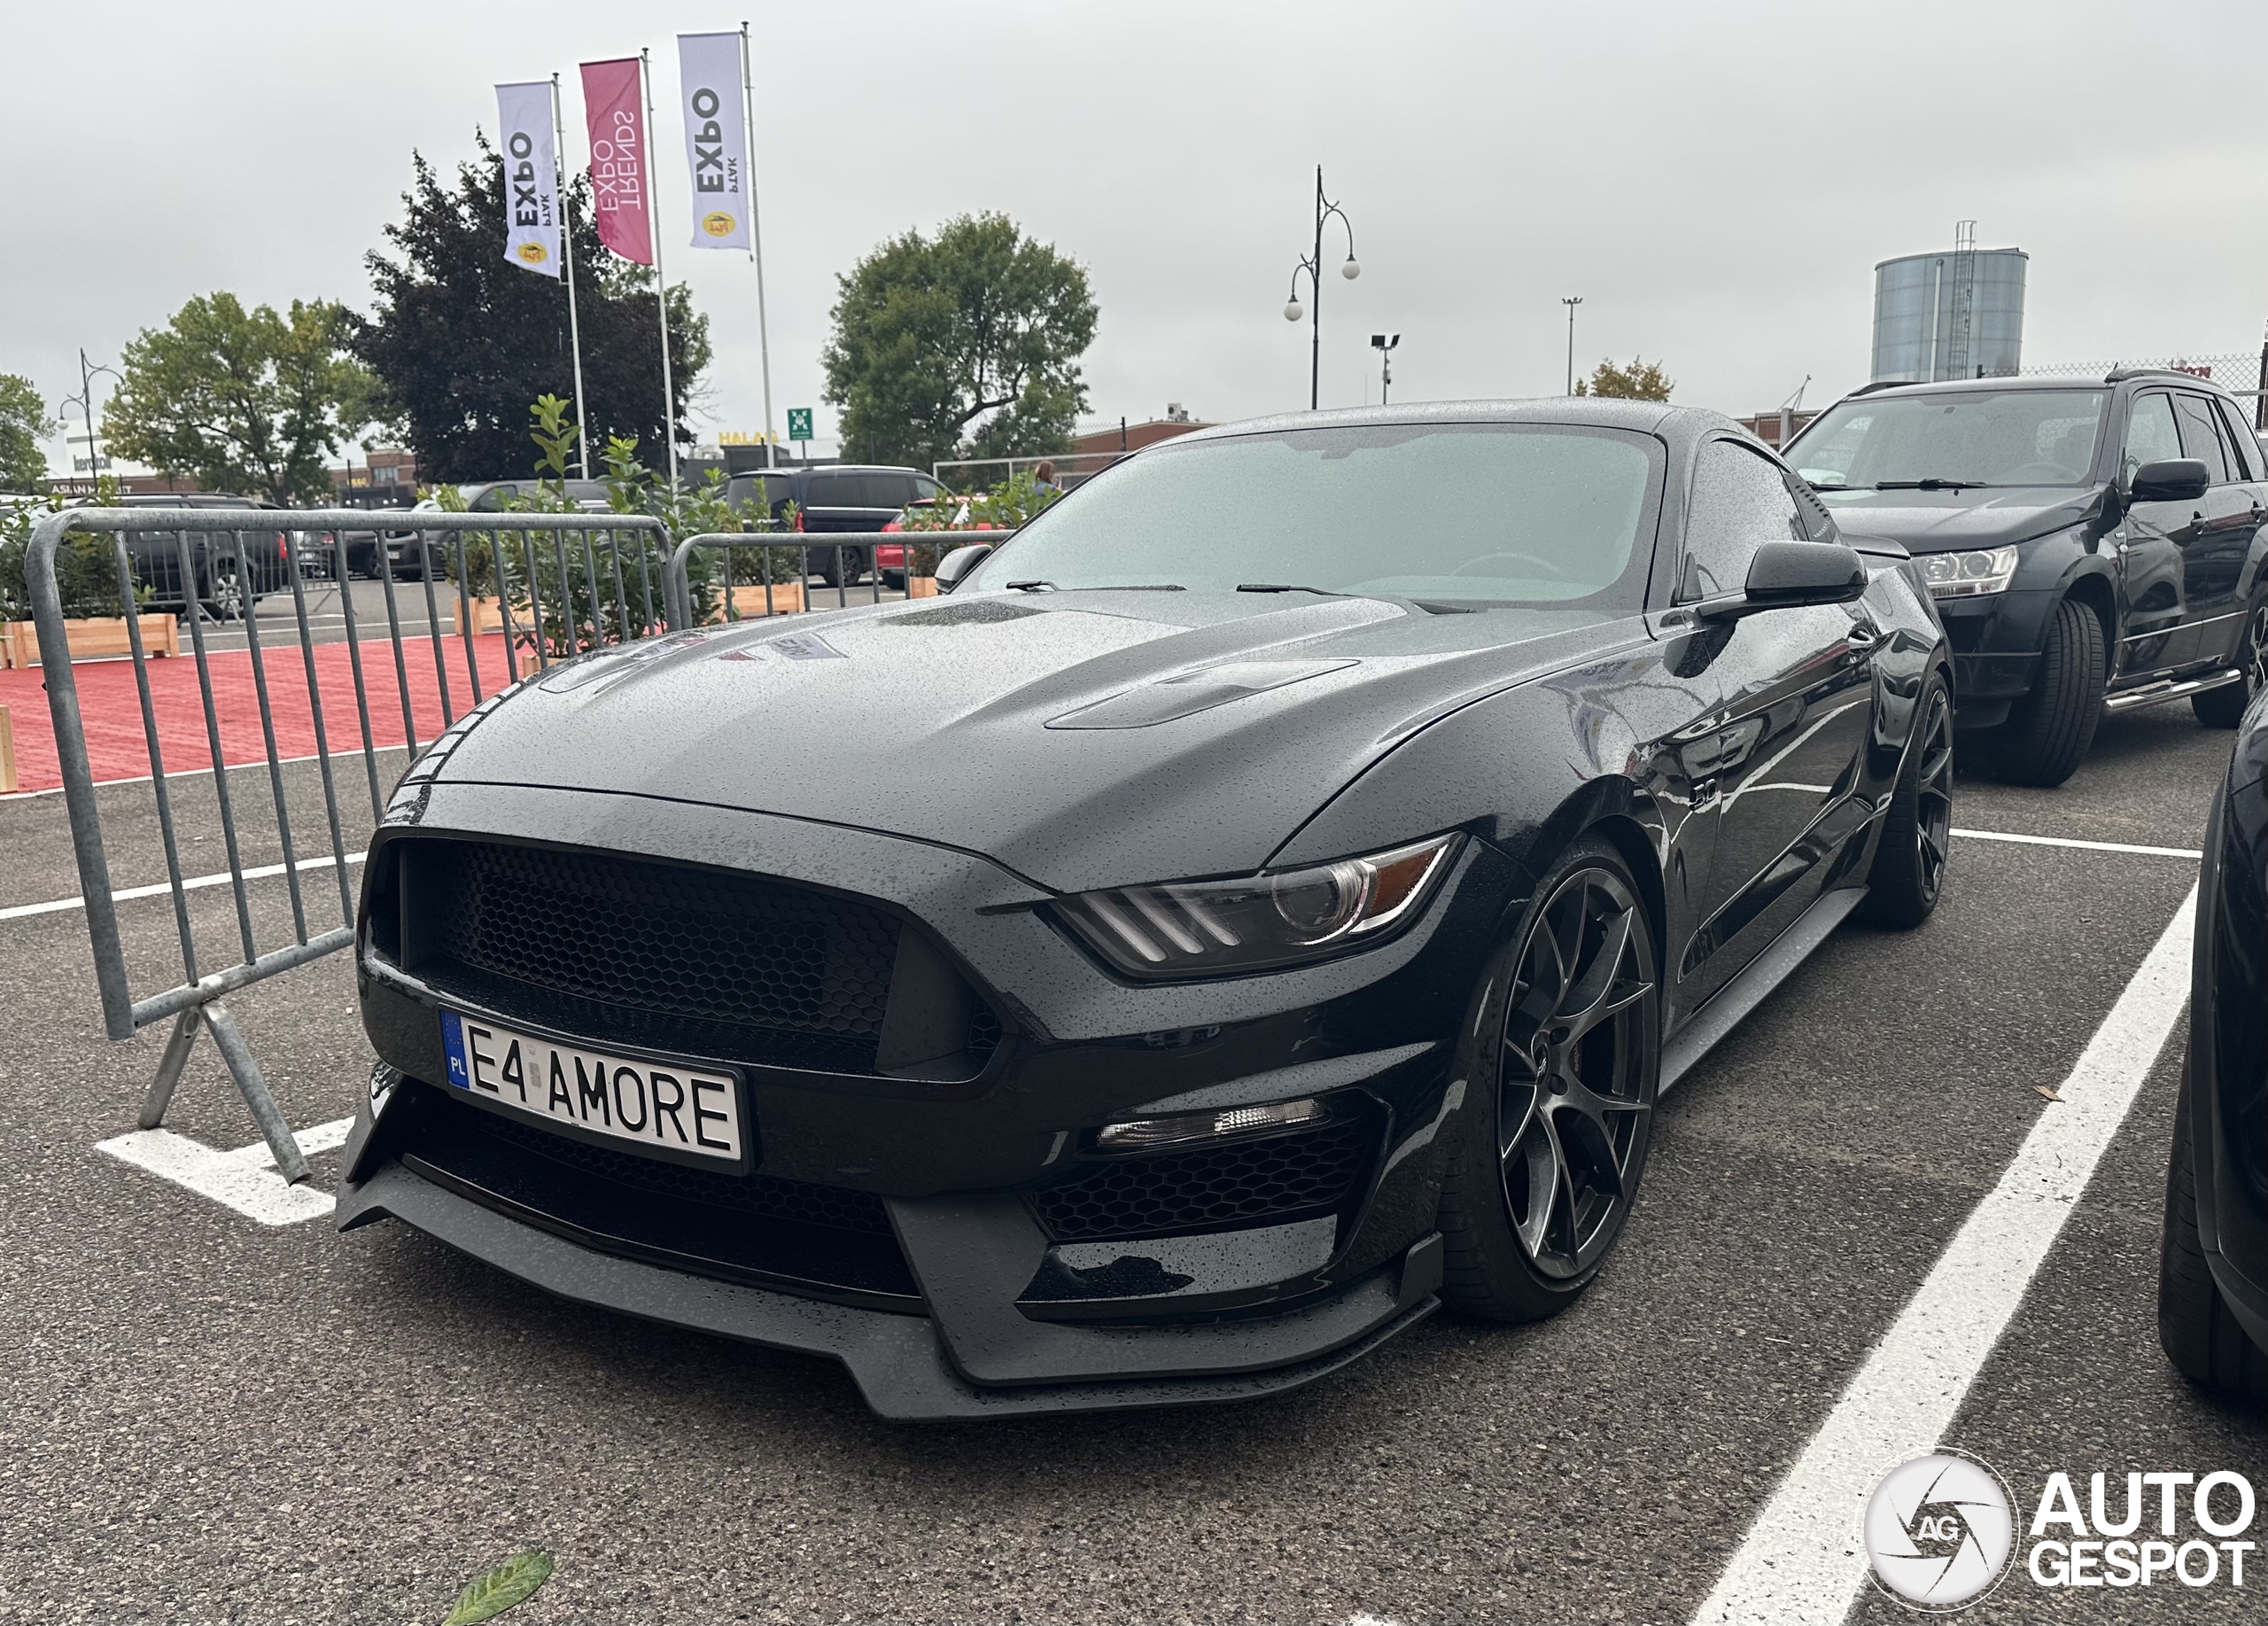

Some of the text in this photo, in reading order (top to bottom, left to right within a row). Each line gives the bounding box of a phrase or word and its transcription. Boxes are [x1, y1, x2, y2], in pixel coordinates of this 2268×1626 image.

[51, 484, 86, 494] ASIAN
[450, 1055, 466, 1077] PL
[468, 1024, 731, 1151] E4 AMORE
